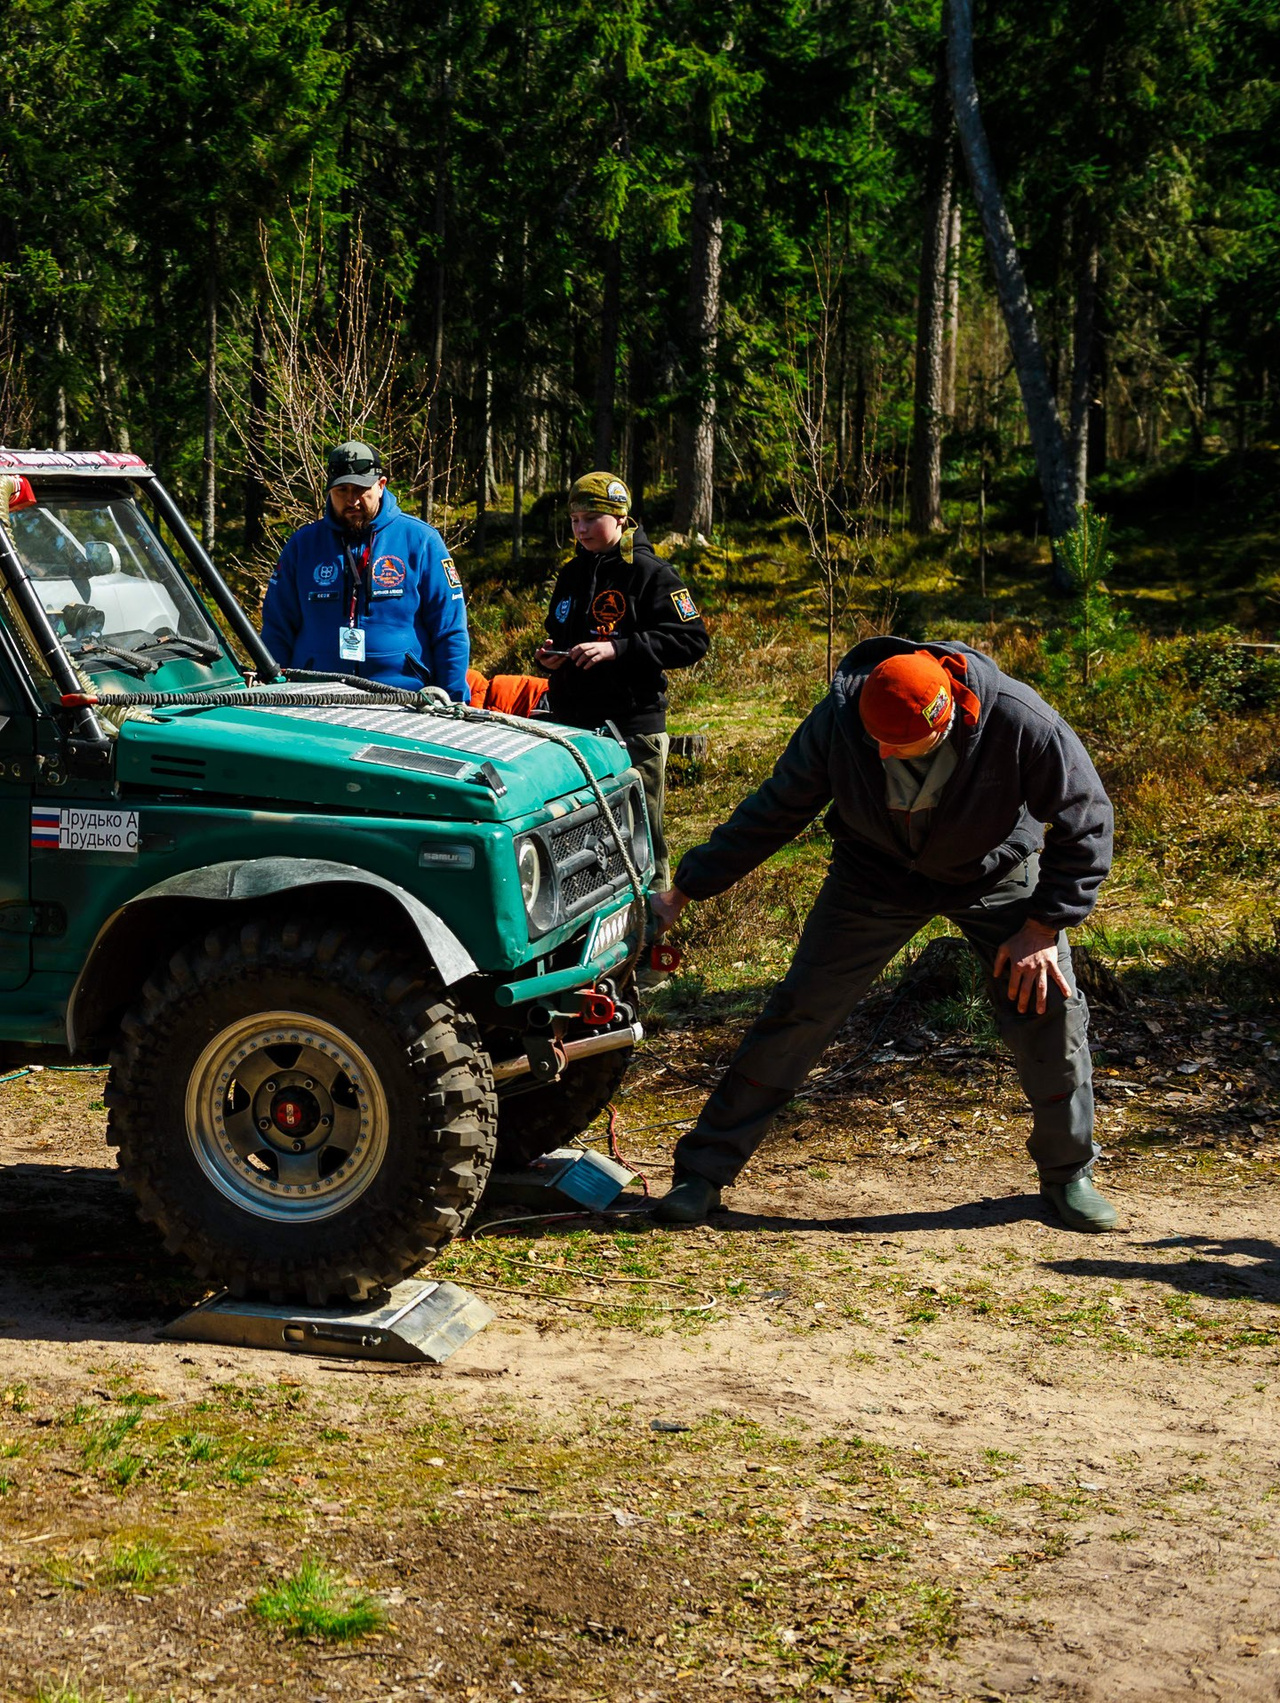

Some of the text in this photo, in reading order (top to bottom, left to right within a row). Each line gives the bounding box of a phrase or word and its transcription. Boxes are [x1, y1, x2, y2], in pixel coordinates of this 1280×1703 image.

[60, 808, 138, 830] Прудько А
[59, 827, 122, 849] Прудько
